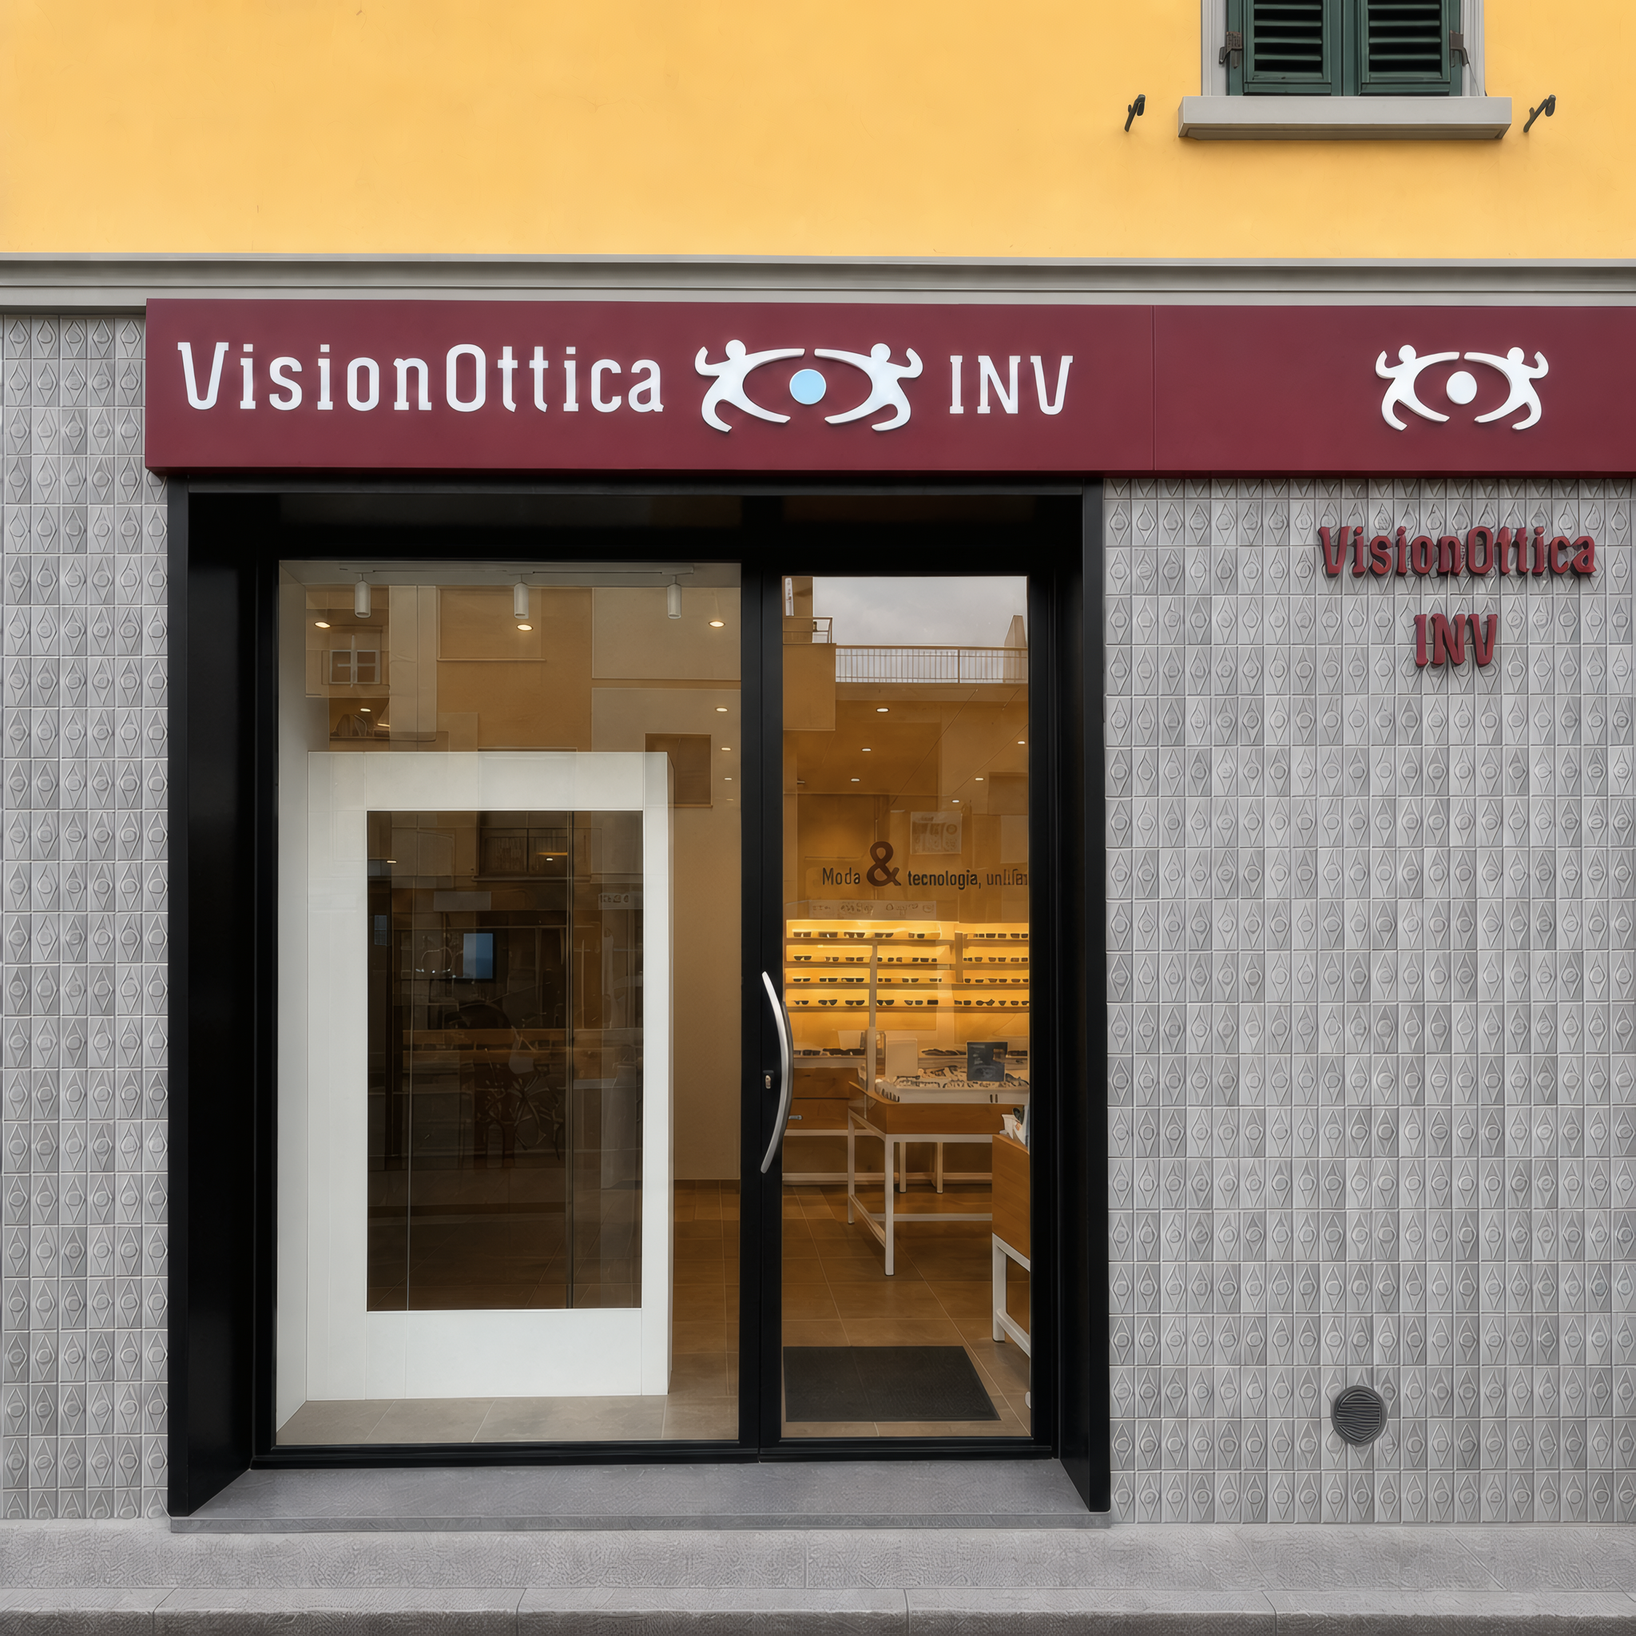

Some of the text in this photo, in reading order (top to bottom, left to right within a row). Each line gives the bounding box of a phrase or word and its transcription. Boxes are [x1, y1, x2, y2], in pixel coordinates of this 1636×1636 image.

[177, 341, 1074, 416] VisionOttica INV
[1318, 525, 1597, 577] VisionOttica
[1414, 613, 1499, 667] INV
[822, 867, 861, 886] Moda
[866, 841, 902, 887] &
[907, 869, 982, 891] tecnologia,
